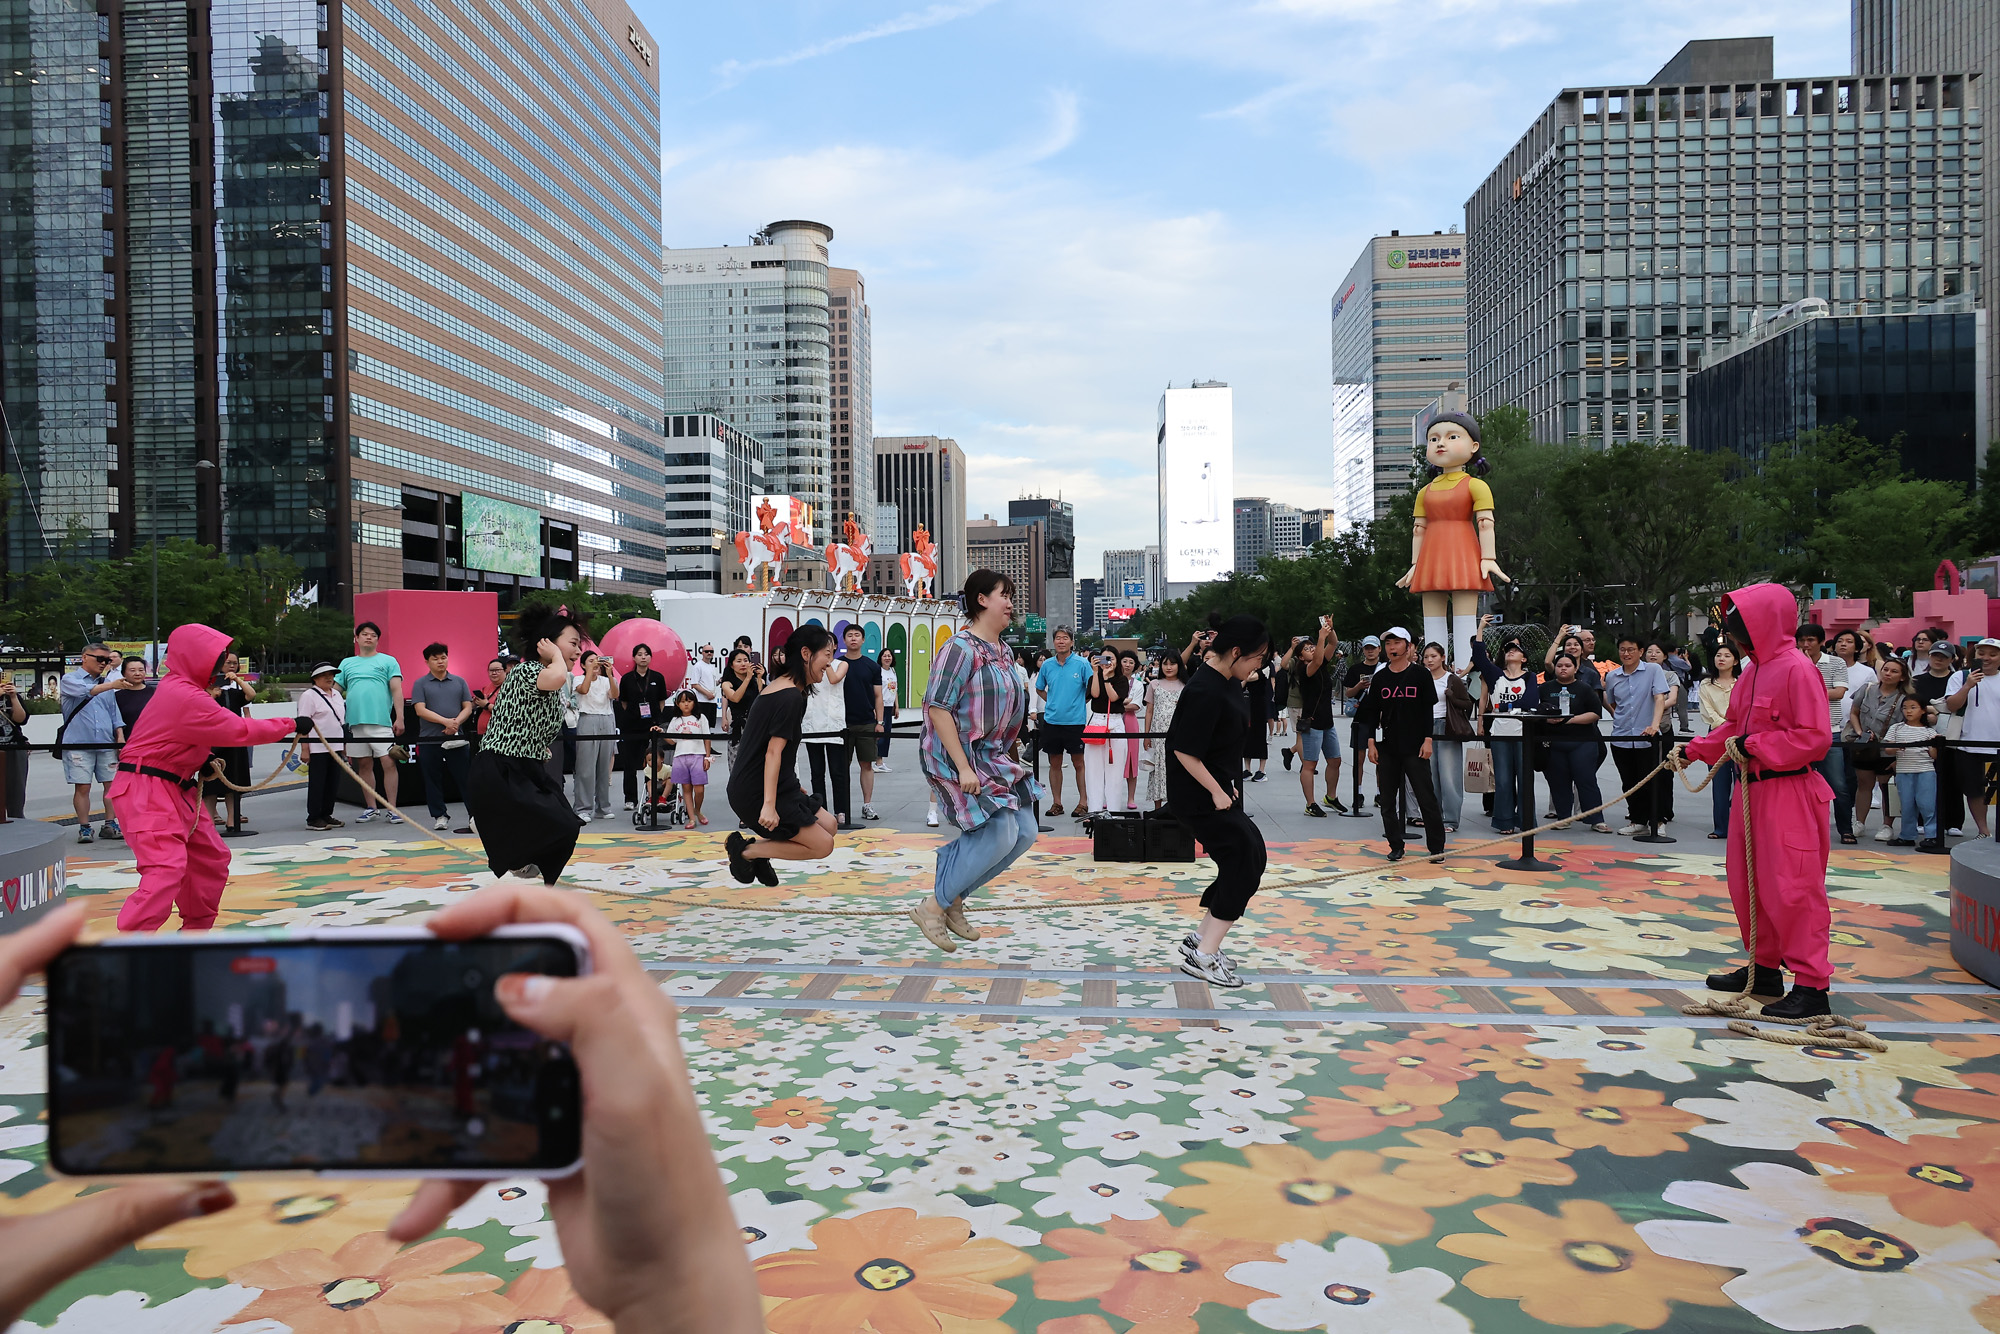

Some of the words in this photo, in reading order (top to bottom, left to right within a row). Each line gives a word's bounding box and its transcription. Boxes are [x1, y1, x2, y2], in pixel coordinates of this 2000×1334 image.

[628, 24, 652, 67] 교보생명
[1407, 247, 1462, 261] 감리회본부
[661, 262, 706, 274] 동아일보
[716, 262, 748, 270] CHANNEL
[1408, 261, 1440, 269] Methodist
[1179, 548, 1204, 557] LG전자
[1505, 686, 1512, 694] I
[1468, 761, 1483, 771] MUJI
